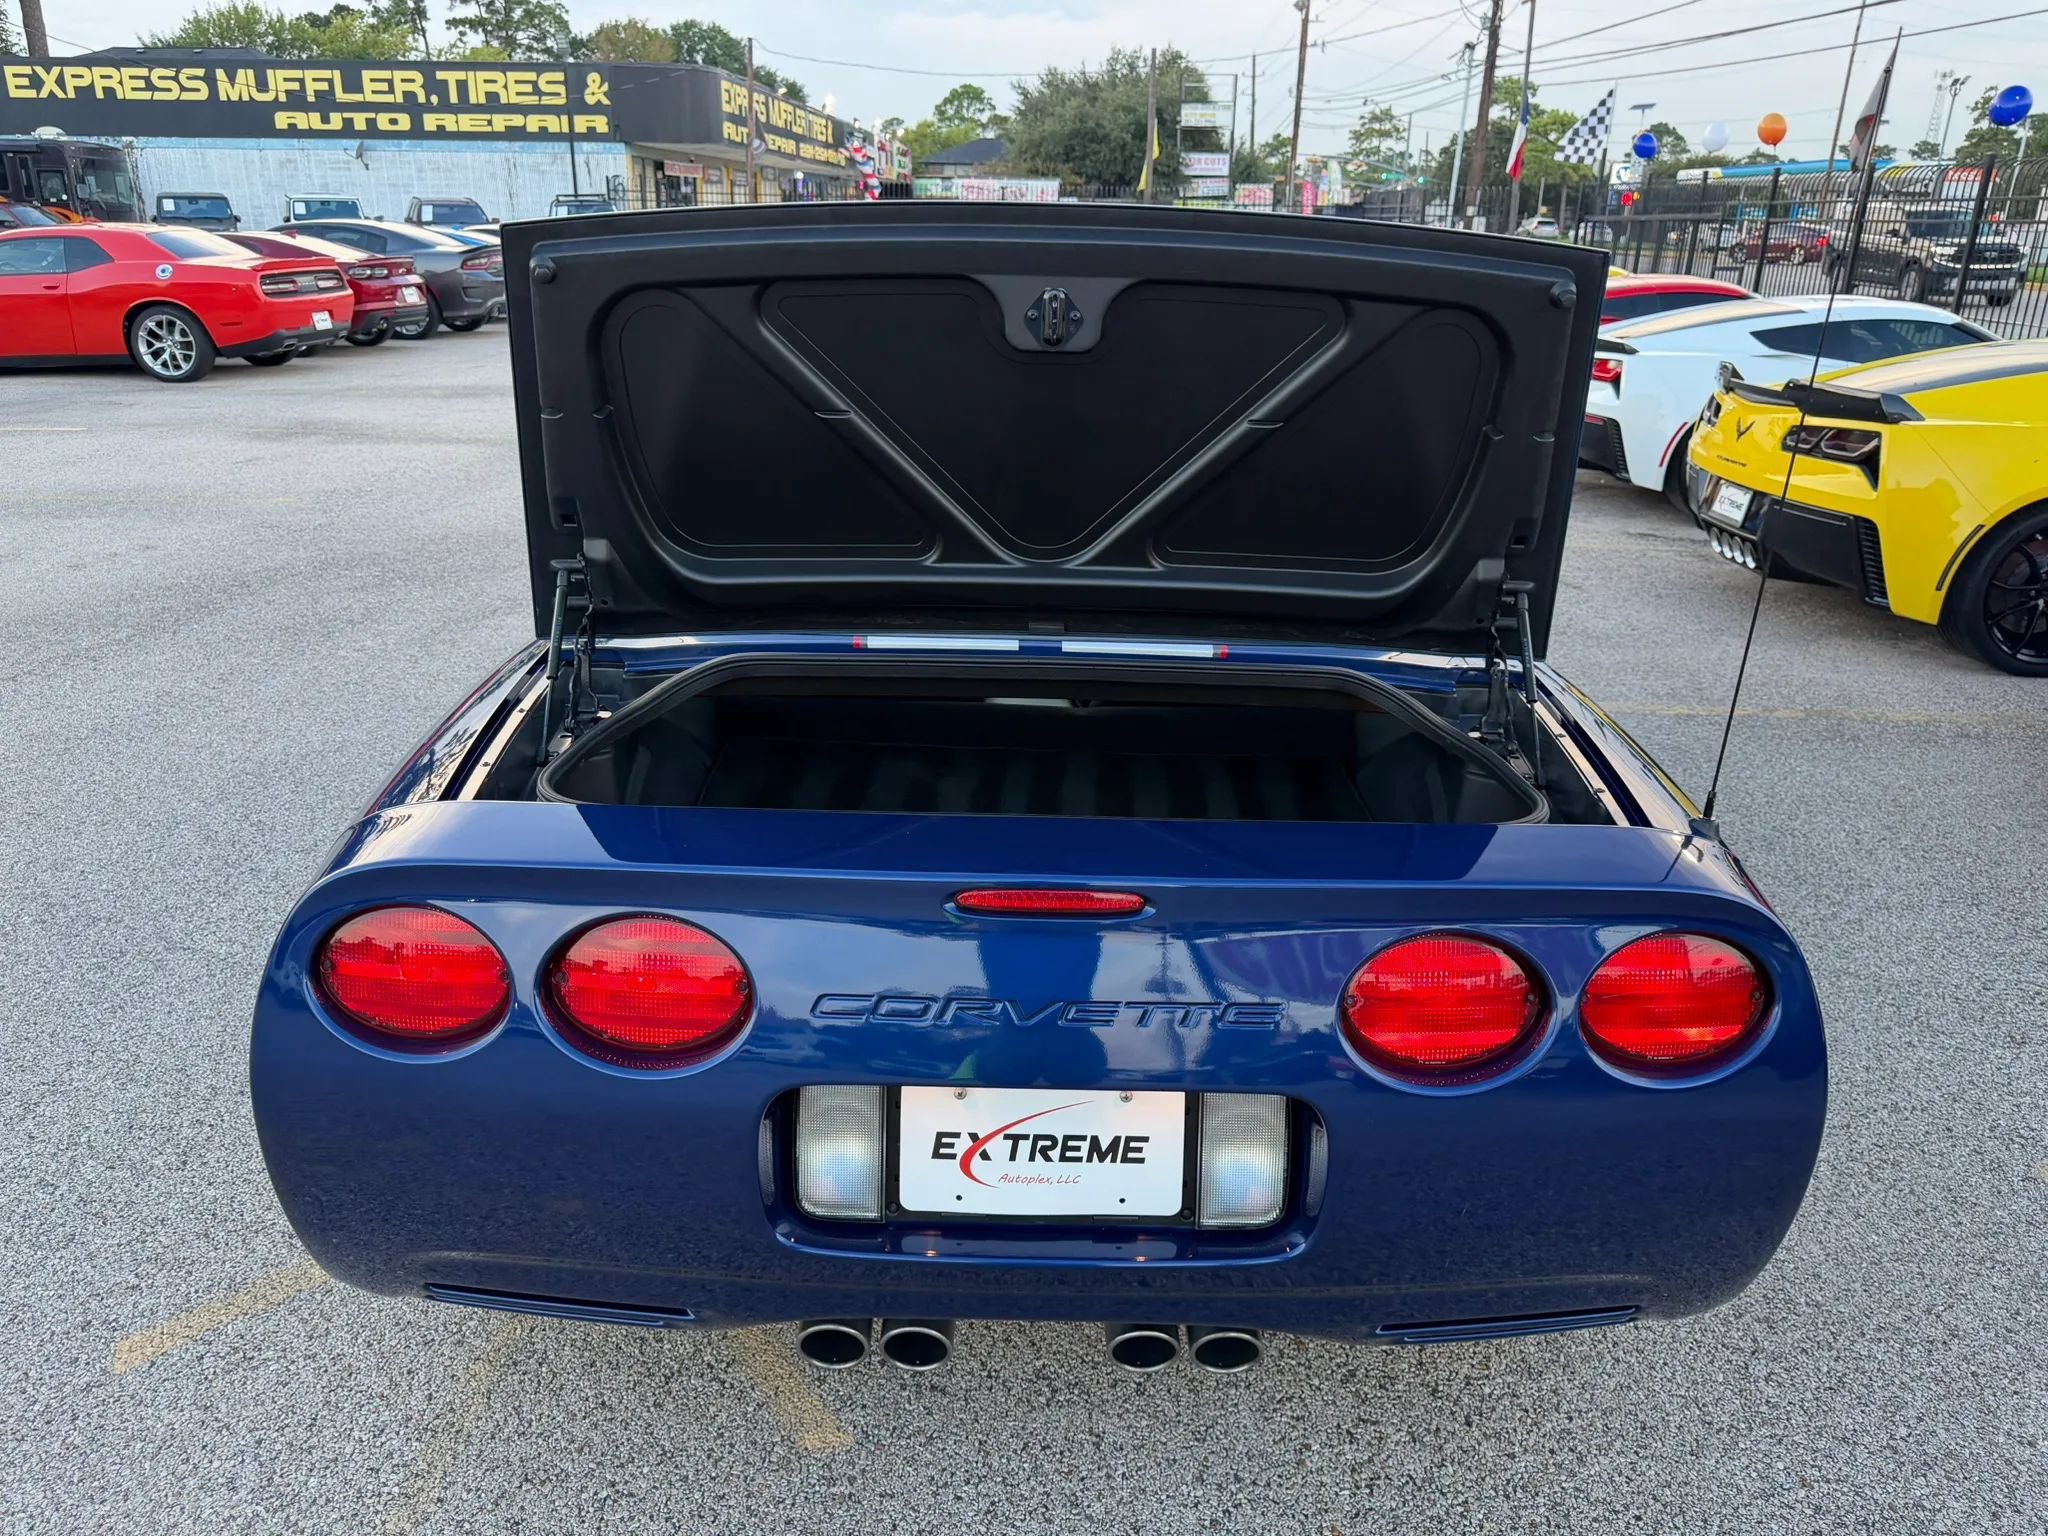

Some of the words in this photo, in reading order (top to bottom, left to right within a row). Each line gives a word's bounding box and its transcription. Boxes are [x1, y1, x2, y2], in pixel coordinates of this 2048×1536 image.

[4, 66, 209, 101] EXPRESS
[584, 72, 611, 105] &
[274, 112, 411, 131] AUTO
[423, 113, 609, 133] REPAIR
[723, 121, 751, 145] AUT
[764, 133, 796, 155] EPAIR
[810, 993, 1288, 1030] CORVETTE
[931, 1131, 1150, 1164] EXTREME
[999, 1173, 1053, 1186] Autoplex,
[1056, 1174, 1082, 1184] LLC
